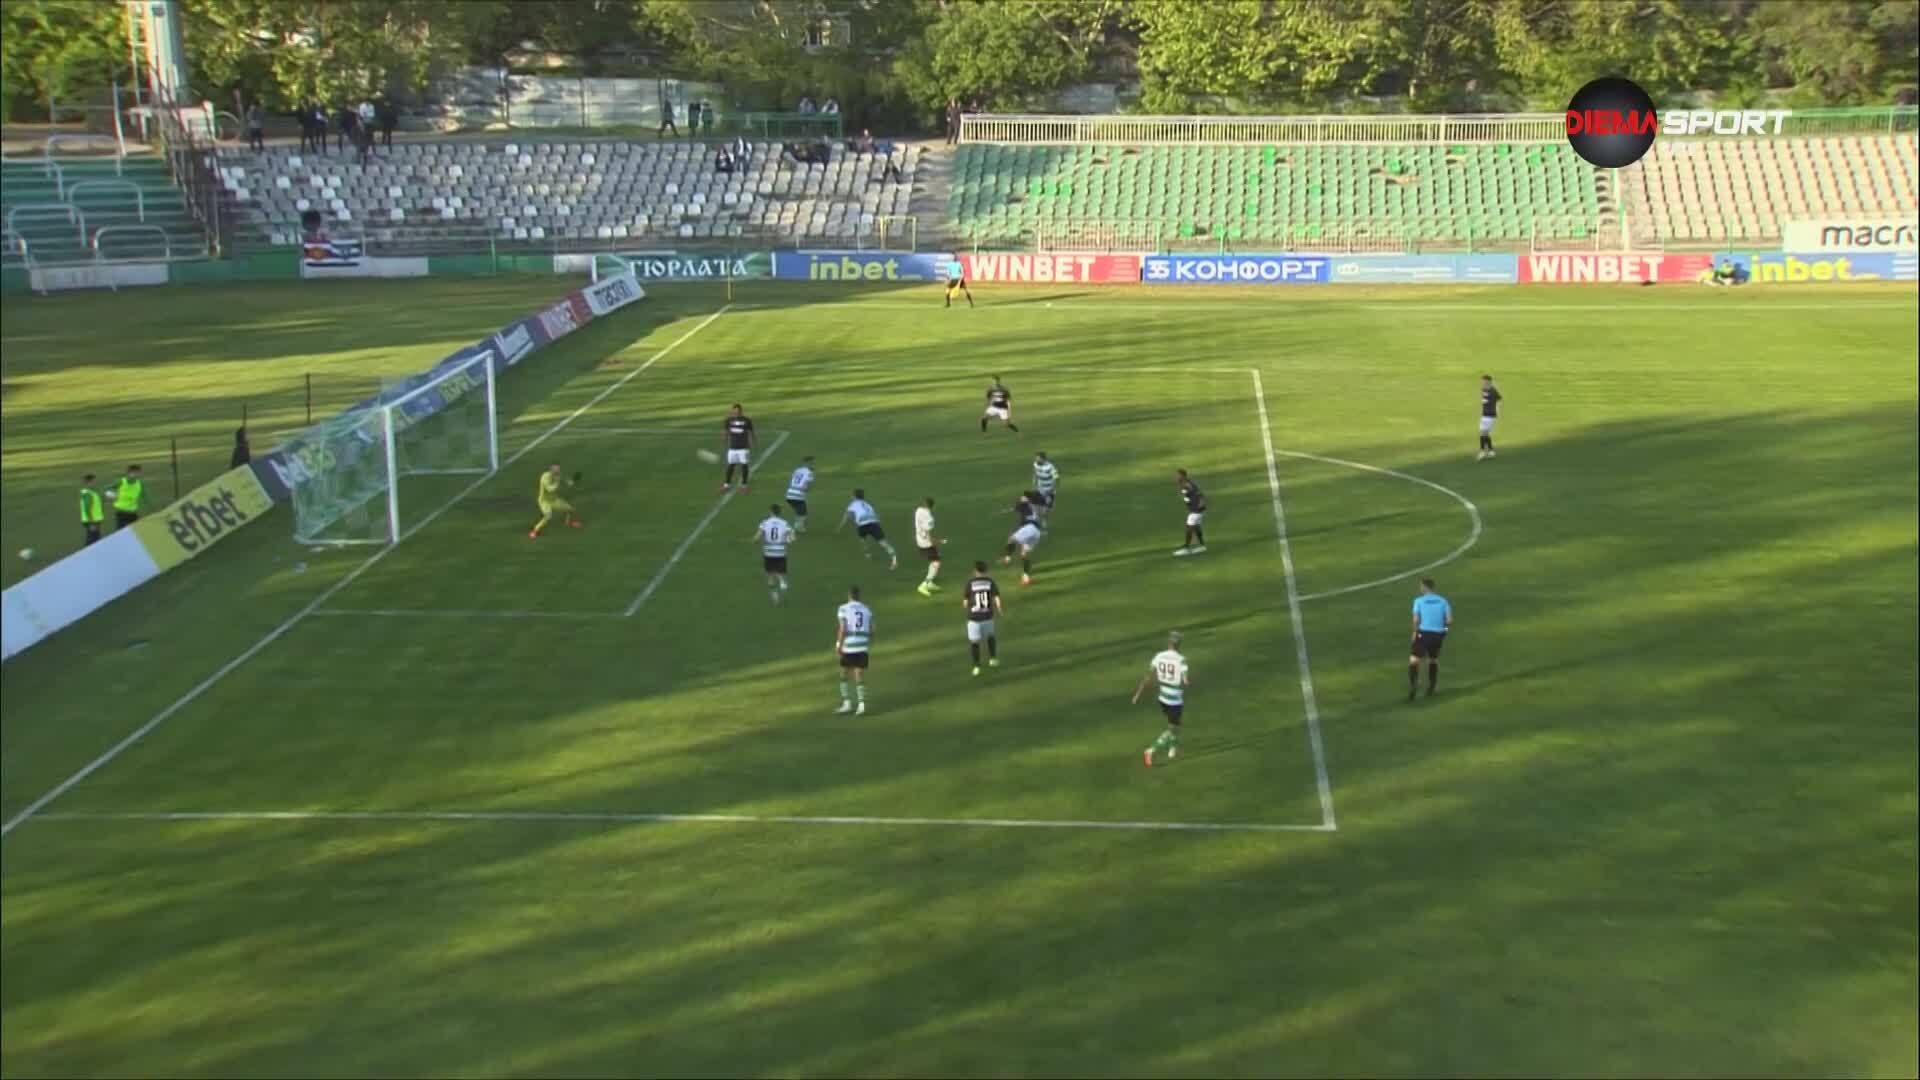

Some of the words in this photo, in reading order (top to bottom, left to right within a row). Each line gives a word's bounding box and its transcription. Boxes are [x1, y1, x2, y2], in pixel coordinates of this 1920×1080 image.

[810, 255, 898, 280] inbet
[969, 255, 1096, 281] WINBET
[1529, 255, 1664, 283] WINBET
[1752, 255, 1852, 282] inbet
[855, 611, 865, 628] 3
